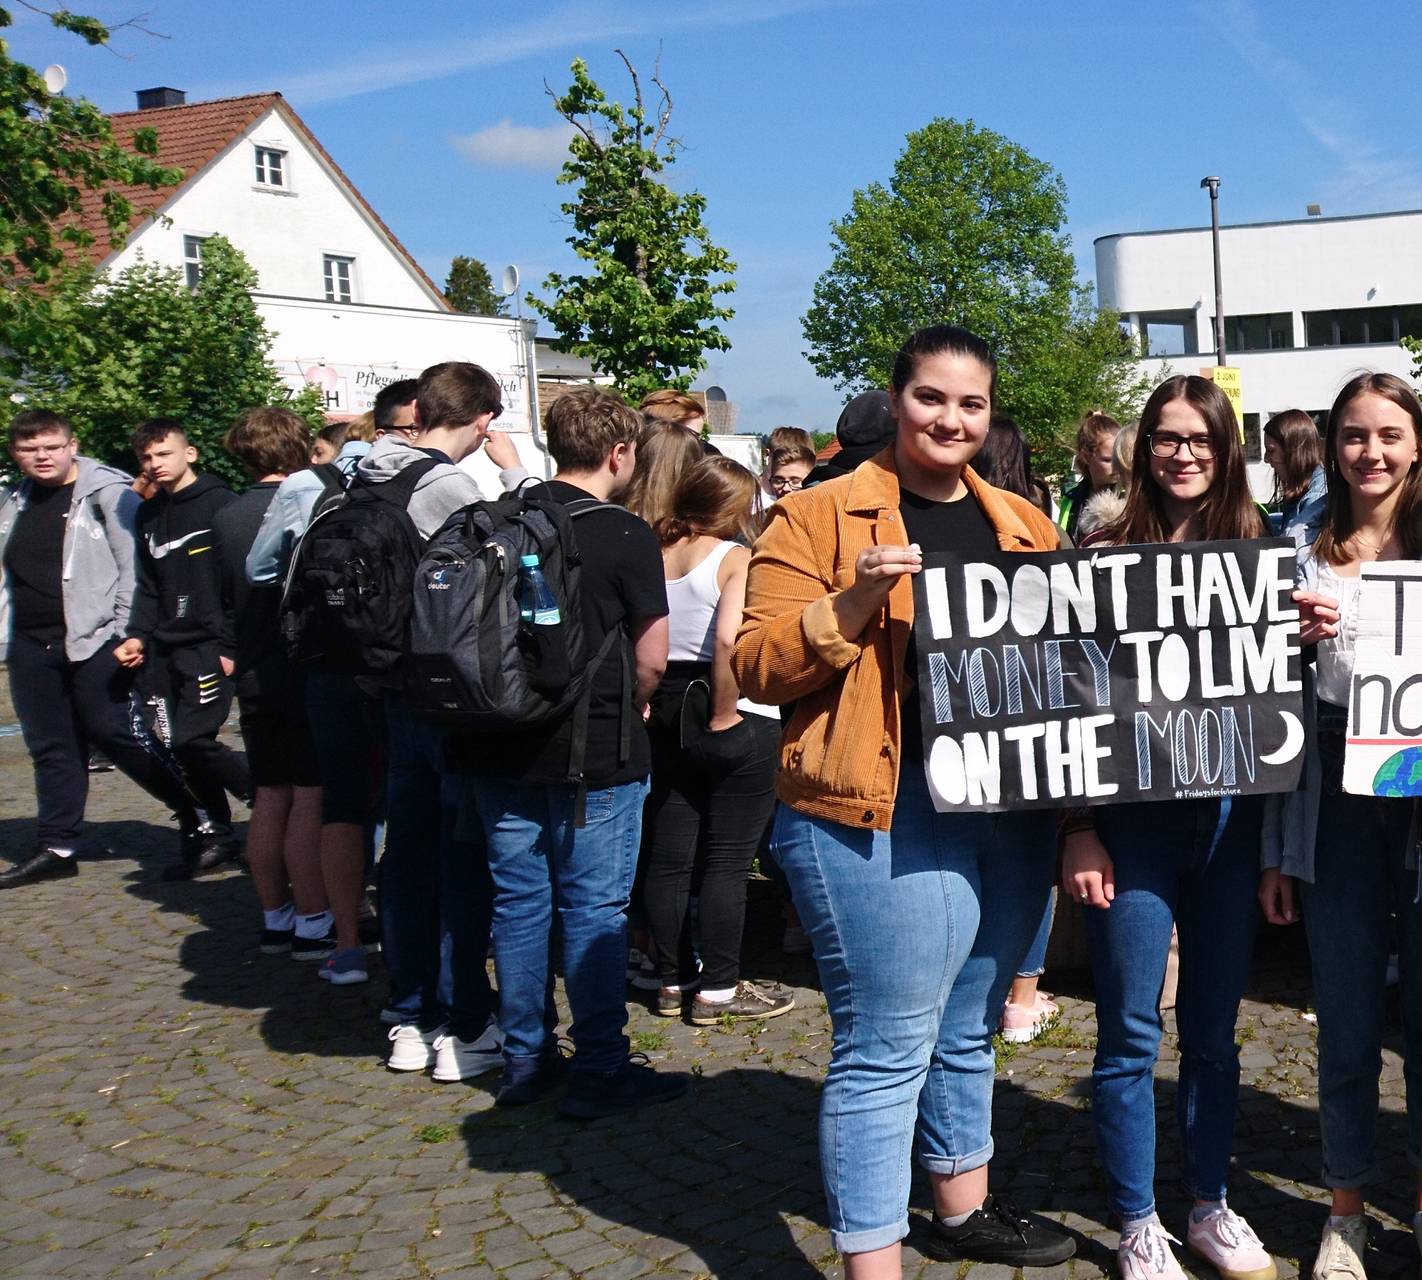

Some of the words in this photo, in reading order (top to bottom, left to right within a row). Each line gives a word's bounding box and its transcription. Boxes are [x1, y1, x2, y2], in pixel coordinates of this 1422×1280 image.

[925, 567, 952, 640] I
[963, 553, 1141, 639] DON'T
[1156, 548, 1300, 628] HAVE
[928, 639, 1117, 724] MONEY
[1119, 631, 1190, 703] TO
[1197, 621, 1303, 699] LIVE
[929, 731, 1001, 806] ON
[1004, 714, 1119, 801] THE
[1134, 704, 1256, 790] MOON
